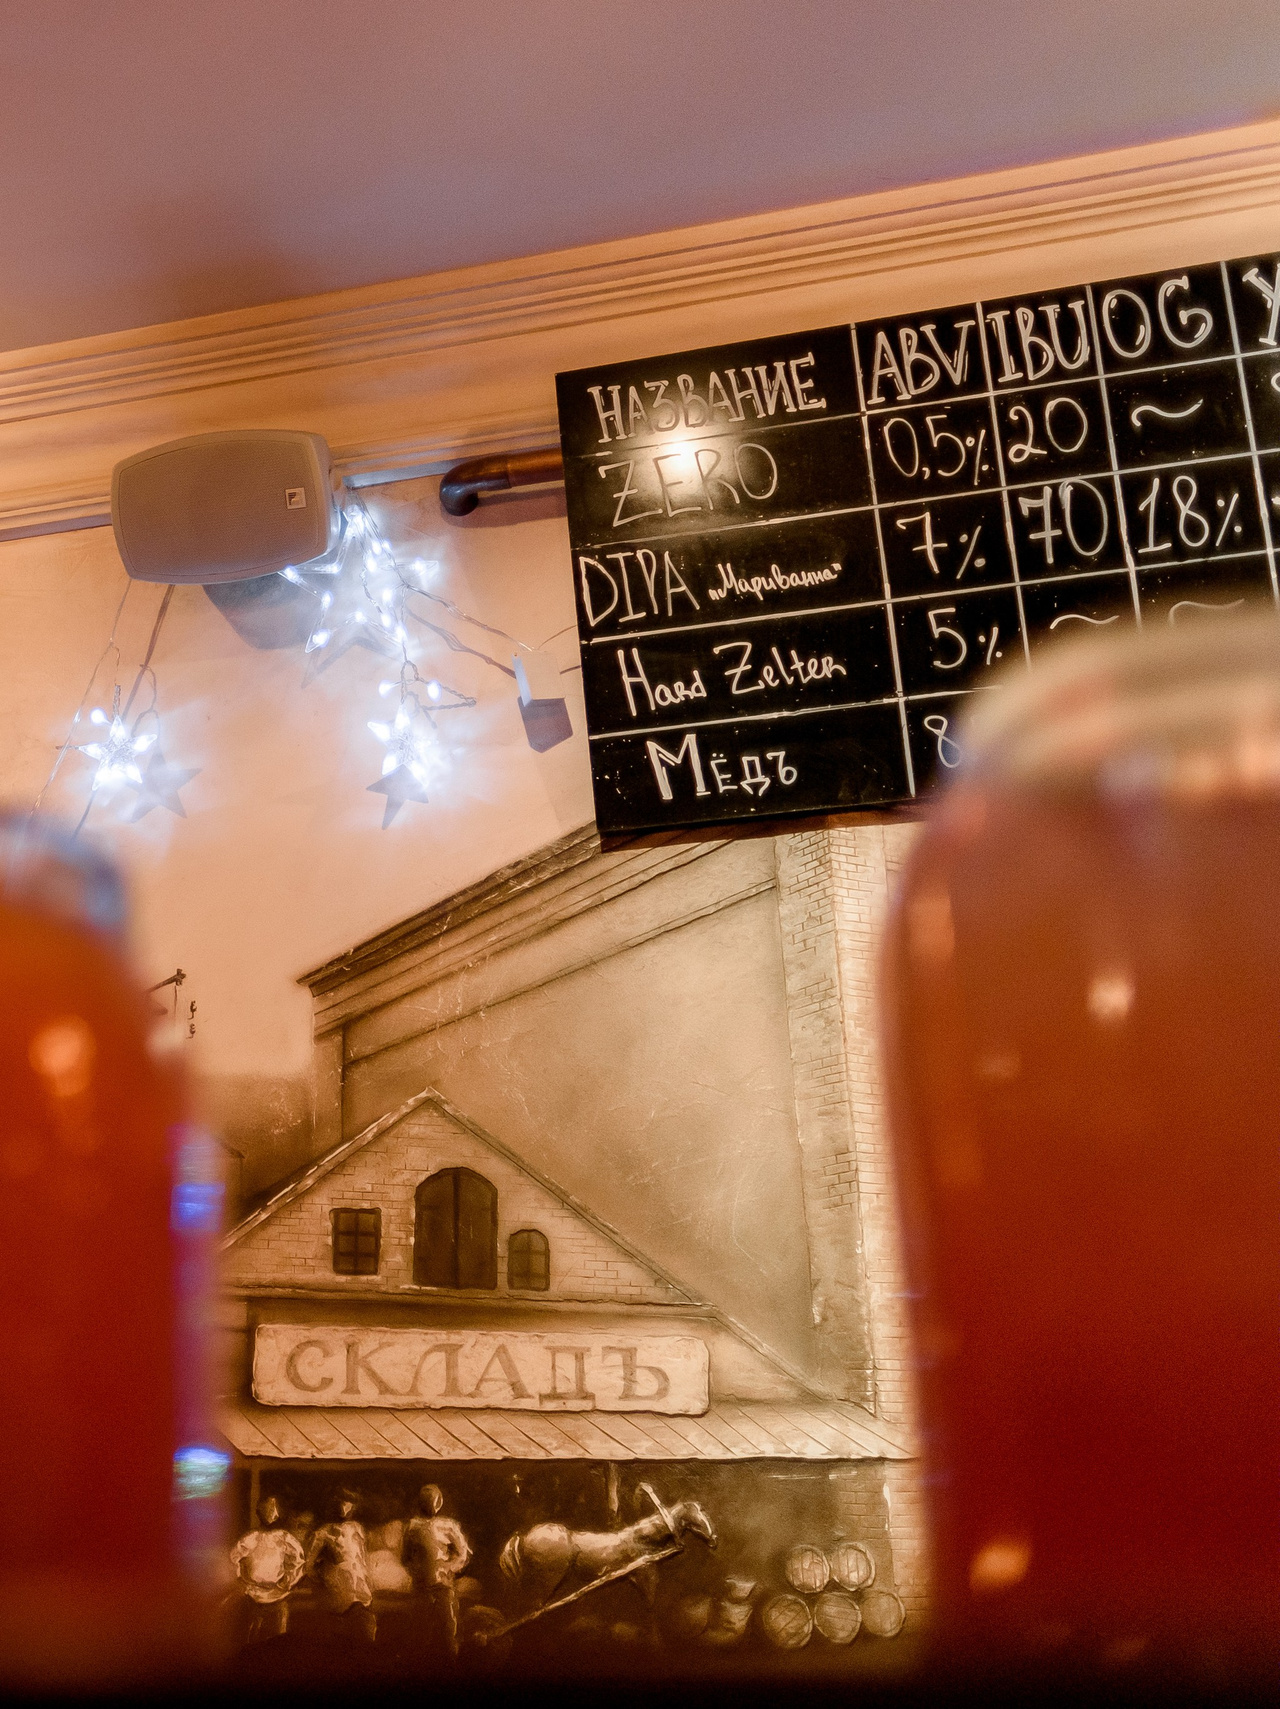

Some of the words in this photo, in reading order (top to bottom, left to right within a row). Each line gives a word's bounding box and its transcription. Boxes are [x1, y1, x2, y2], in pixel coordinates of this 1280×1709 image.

[987, 300, 1091, 383] IBU
[1103, 275, 1214, 359] OG
[586, 351, 827, 443] НАЗВАНИЕ
[867, 318, 976, 405] ABV
[1007, 396, 1089, 463] 20
[598, 443, 778, 527] ZERO
[1018, 478, 1109, 564] 70
[1137, 474, 1243, 554] 18%
[896, 511, 986, 579] 7%
[578, 548, 700, 628] DIPA
[927, 607, 1003, 669] 5%
[284, 1337, 672, 1409] СКЛАДЪ
